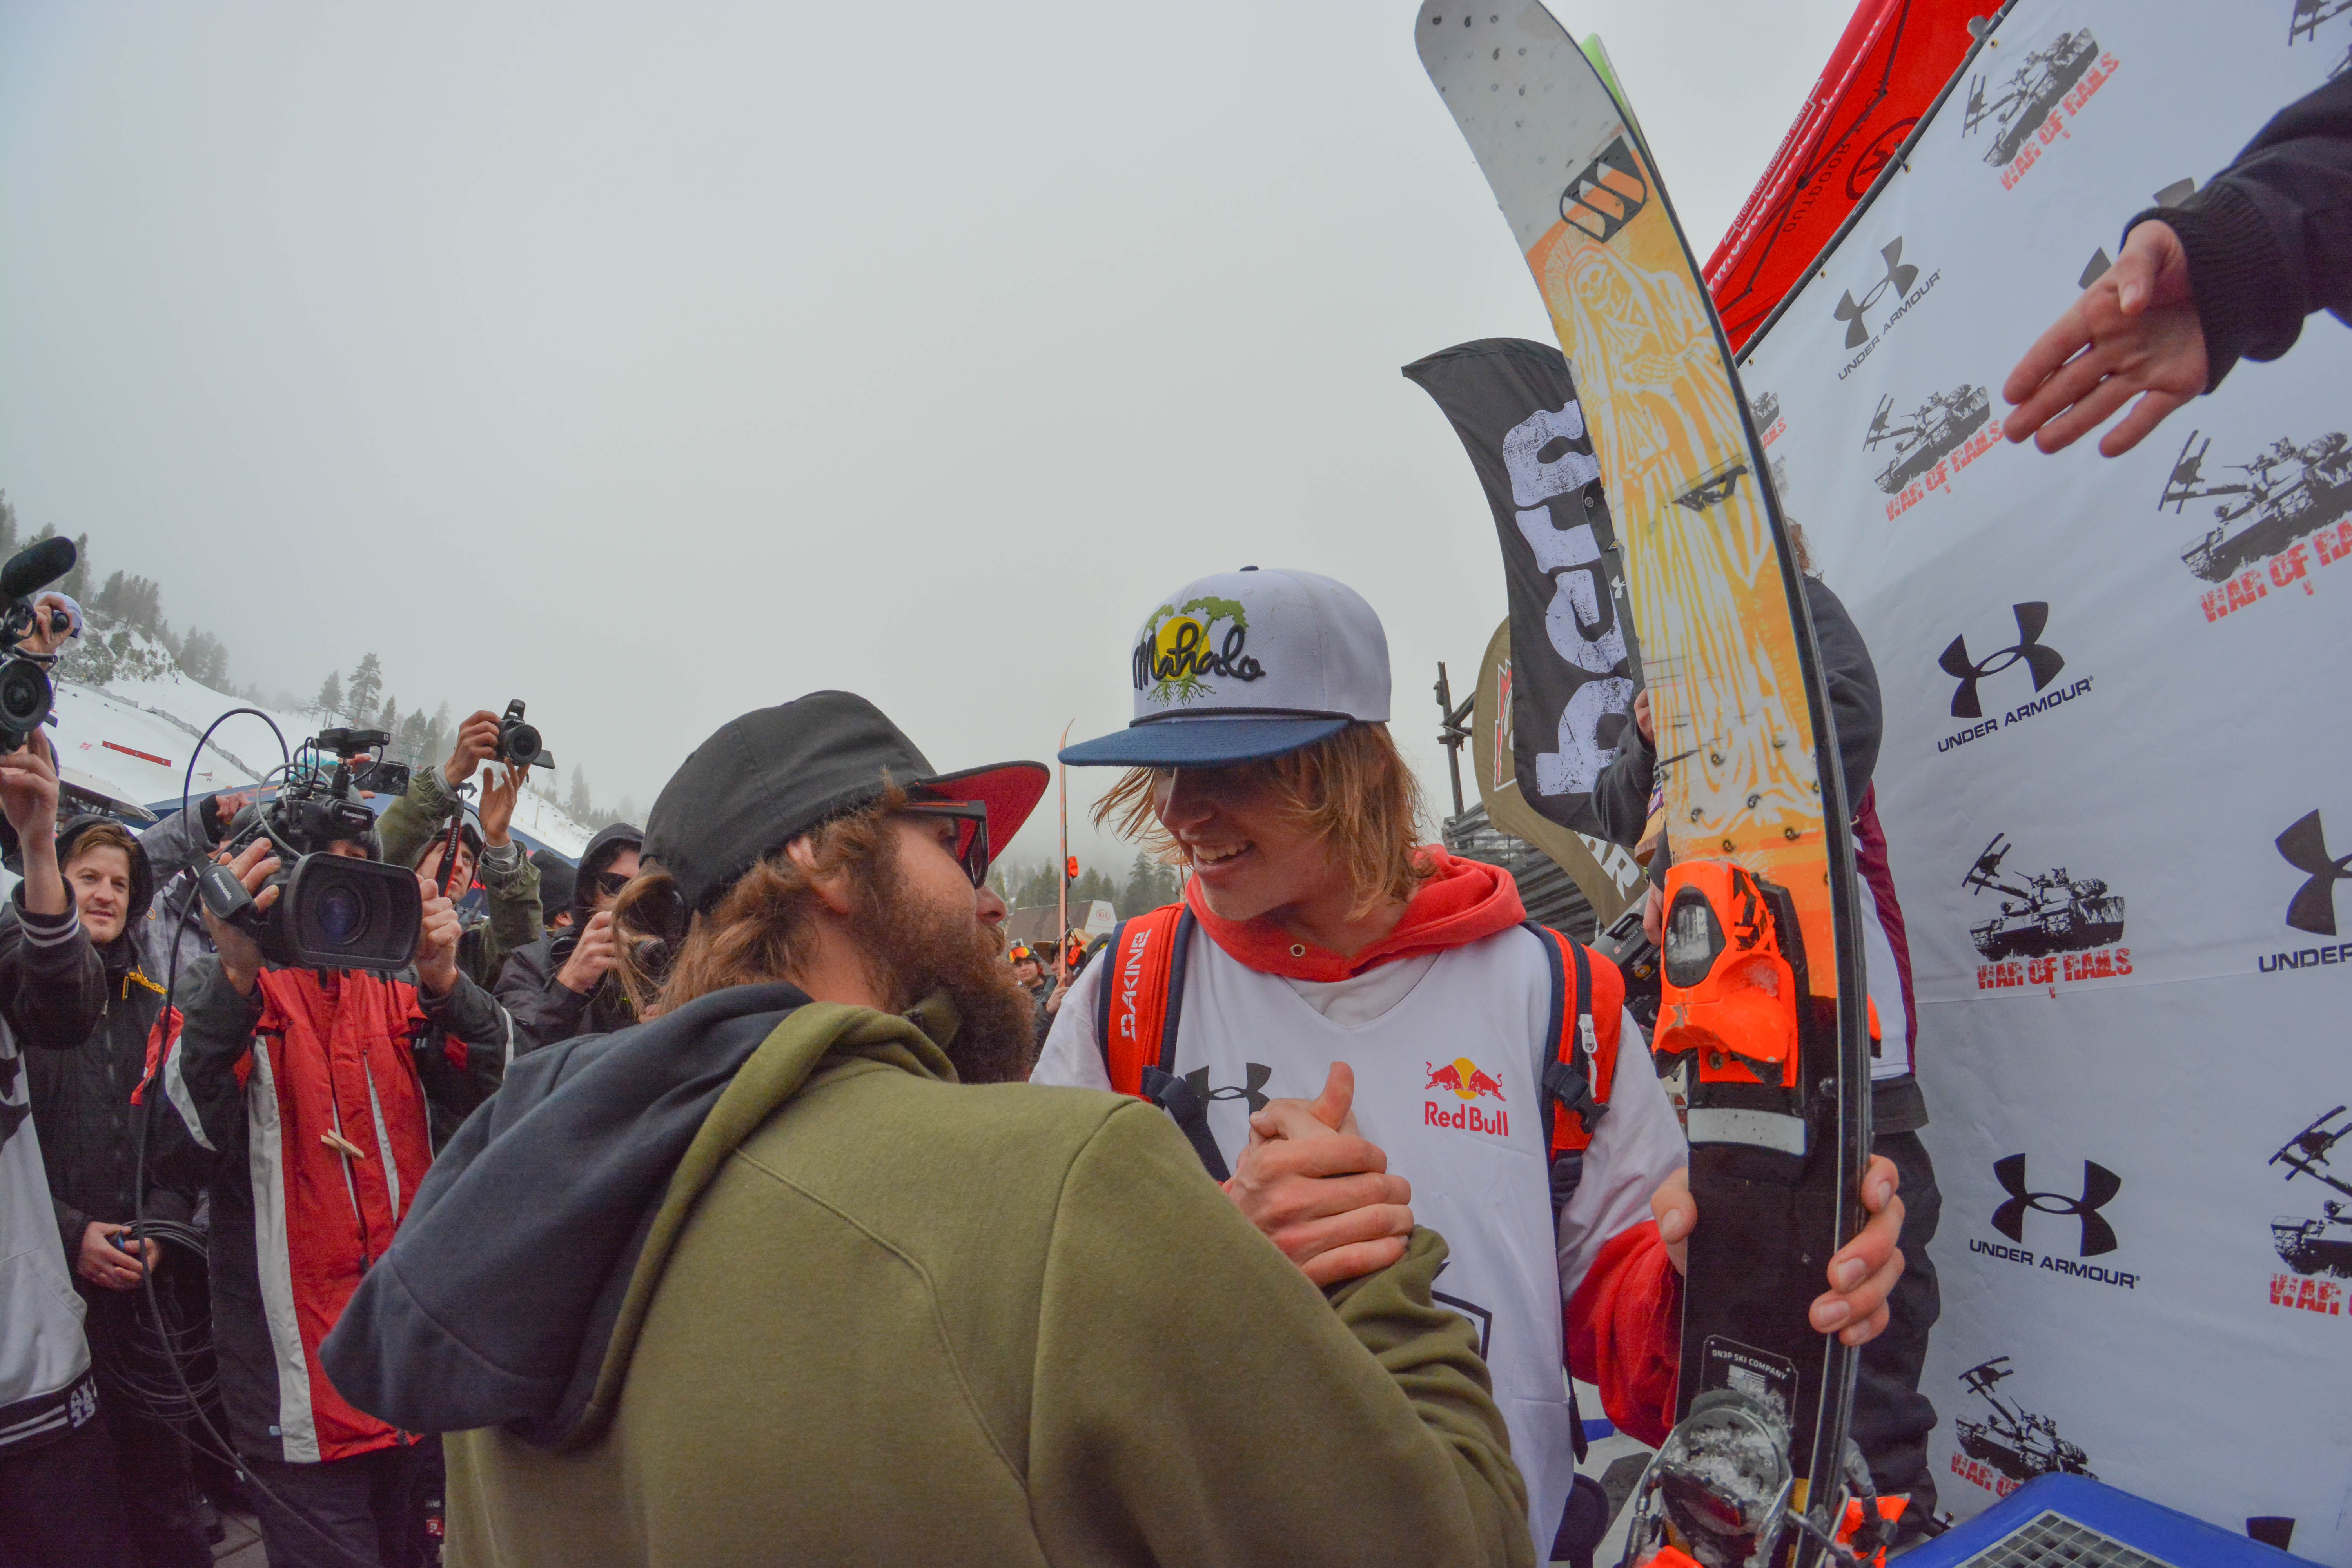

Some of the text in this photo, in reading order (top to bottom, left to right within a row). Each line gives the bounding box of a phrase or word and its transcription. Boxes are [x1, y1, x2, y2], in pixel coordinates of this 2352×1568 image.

[1838, 335, 1880, 380] UNDER
[1763, 417, 1786, 450] AILS
[2200, 570, 2268, 623] WAR
[2268, 543, 2308, 587] OF
[1132, 622, 1266, 691] Mahalo
[1937, 719, 1998, 752] UNDER
[342, 810, 367, 820] Panasonic
[445, 828, 458, 861] Canon
[212, 872, 232, 900] Panasonic
[1121, 928, 1152, 1042] DAKINE
[1976, 947, 2133, 989] WAR OF RAILS
[1425, 1101, 1508, 1137] Red Bull
[1969, 1238, 2034, 1265] UNDER
[2270, 1273, 2341, 1316] WAR
[1734, 1353, 1747, 1363] SKI
[1749, 1358, 1788, 1380] COMPANY
[1951, 1452, 1993, 1490] WAR
